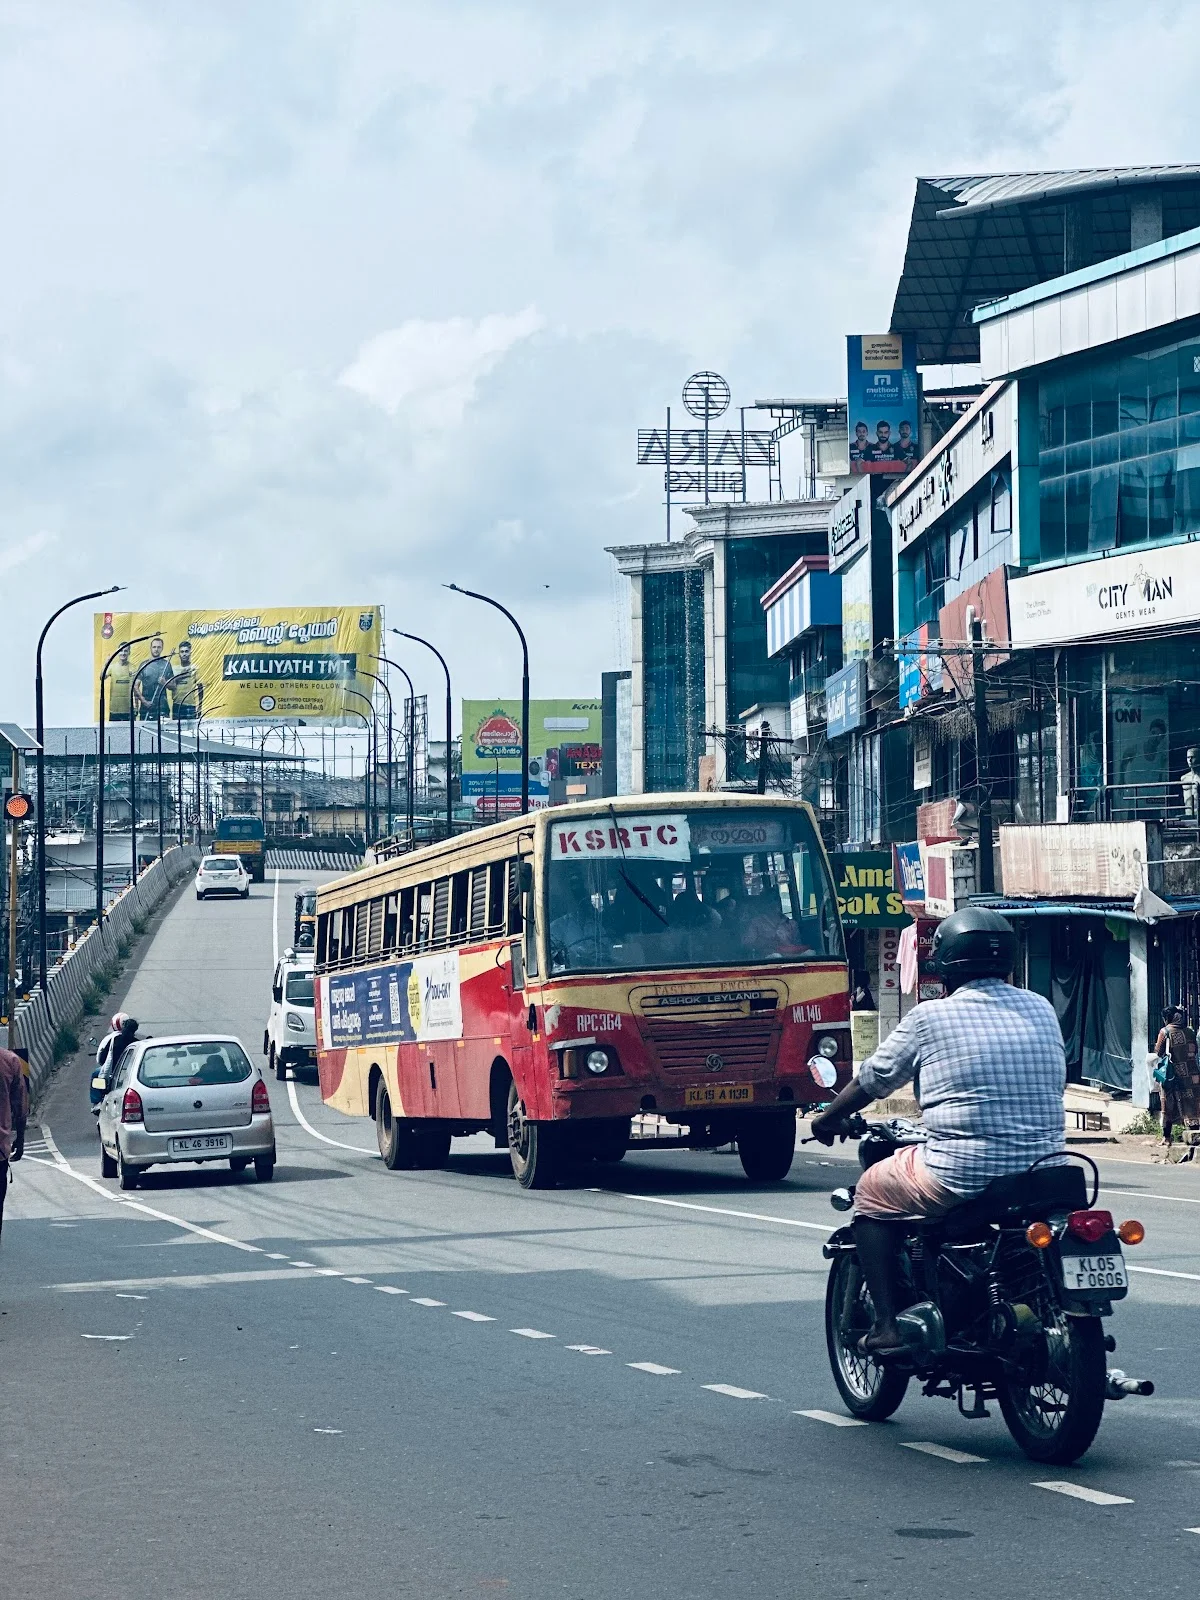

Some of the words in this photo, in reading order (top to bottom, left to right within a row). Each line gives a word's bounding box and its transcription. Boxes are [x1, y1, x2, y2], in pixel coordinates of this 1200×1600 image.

[866, 386, 899, 394] muthoot
[1098, 583, 1129, 610] CITY
[1115, 609, 1135, 620] GENTS
[1139, 606, 1156, 616] WEAR
[224, 659, 313, 675] KALLIYATH
[318, 660, 350, 674] TMT
[1115, 708, 1141, 723] ONN
[558, 824, 678, 854] KSRTC
[837, 892, 880, 915] ook
[887, 892, 906, 915] S
[883, 929, 897, 988] BOOKS
[661, 995, 700, 1006] ASHOK
[707, 992, 760, 1003] LEYLAND
[690, 1091, 702, 1100] KL
[719, 1089, 726, 1099] A
[729, 1088, 748, 1099] 1139
[180, 1140, 189, 1149] KL
[192, 1140, 201, 1148] 46
[205, 1138, 224, 1147] 3916
[1079, 1257, 1115, 1272] KL05
[1076, 1273, 1083, 1287] F
[1088, 1272, 1123, 1287] 0606
